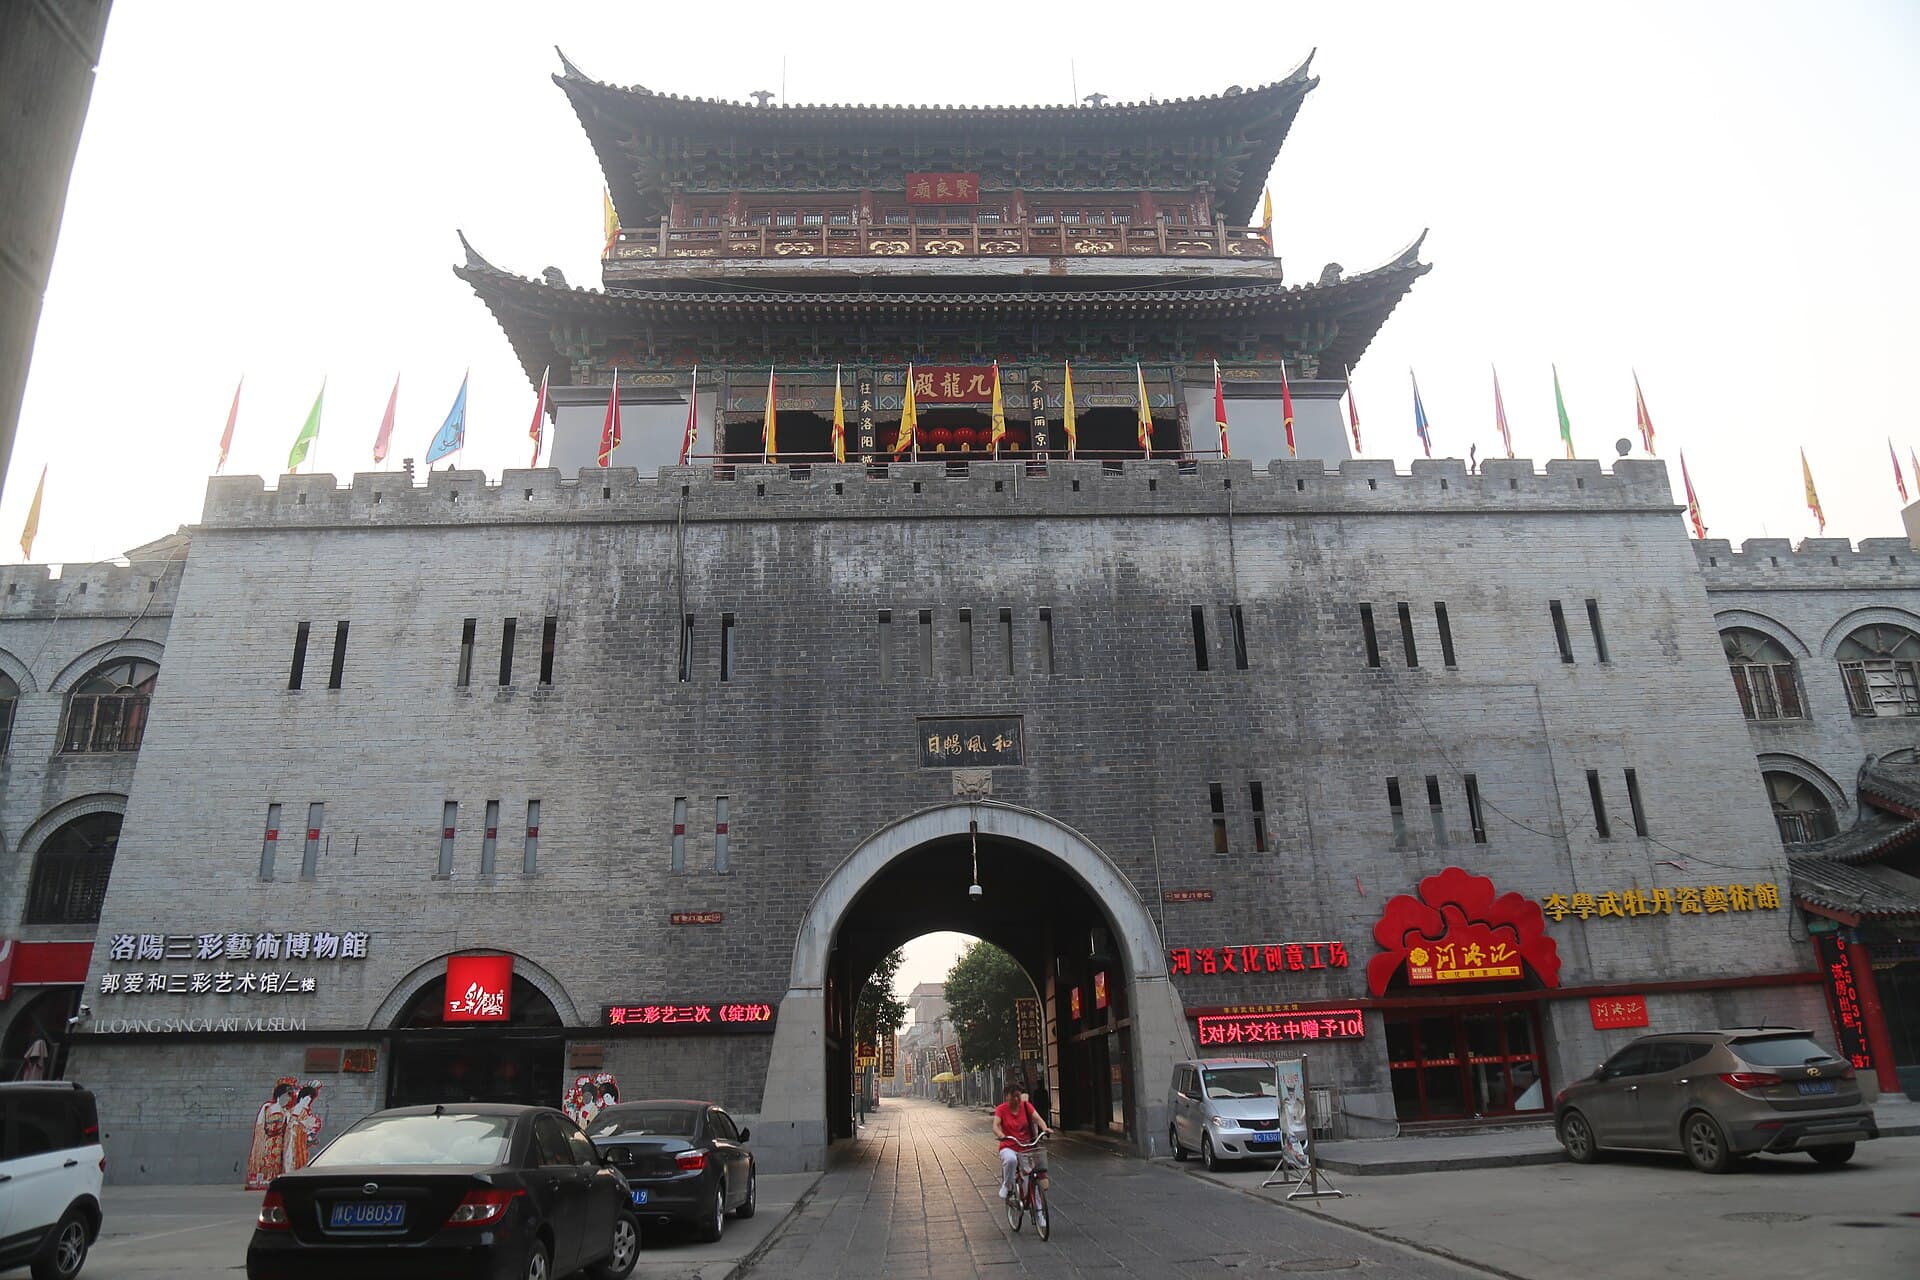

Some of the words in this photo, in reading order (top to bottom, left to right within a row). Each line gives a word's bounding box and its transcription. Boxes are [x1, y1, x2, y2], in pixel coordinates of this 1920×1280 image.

[109, 931, 370, 961] 洛陽三彩藝術博物館
[1171, 942, 1350, 976] 河洛文化创意工场
[94, 1018, 161, 1034] LUOYANG
[163, 1017, 212, 1033] SANCAI
[214, 1017, 241, 1032] ART
[245, 1017, 306, 1032] MUSEUM
